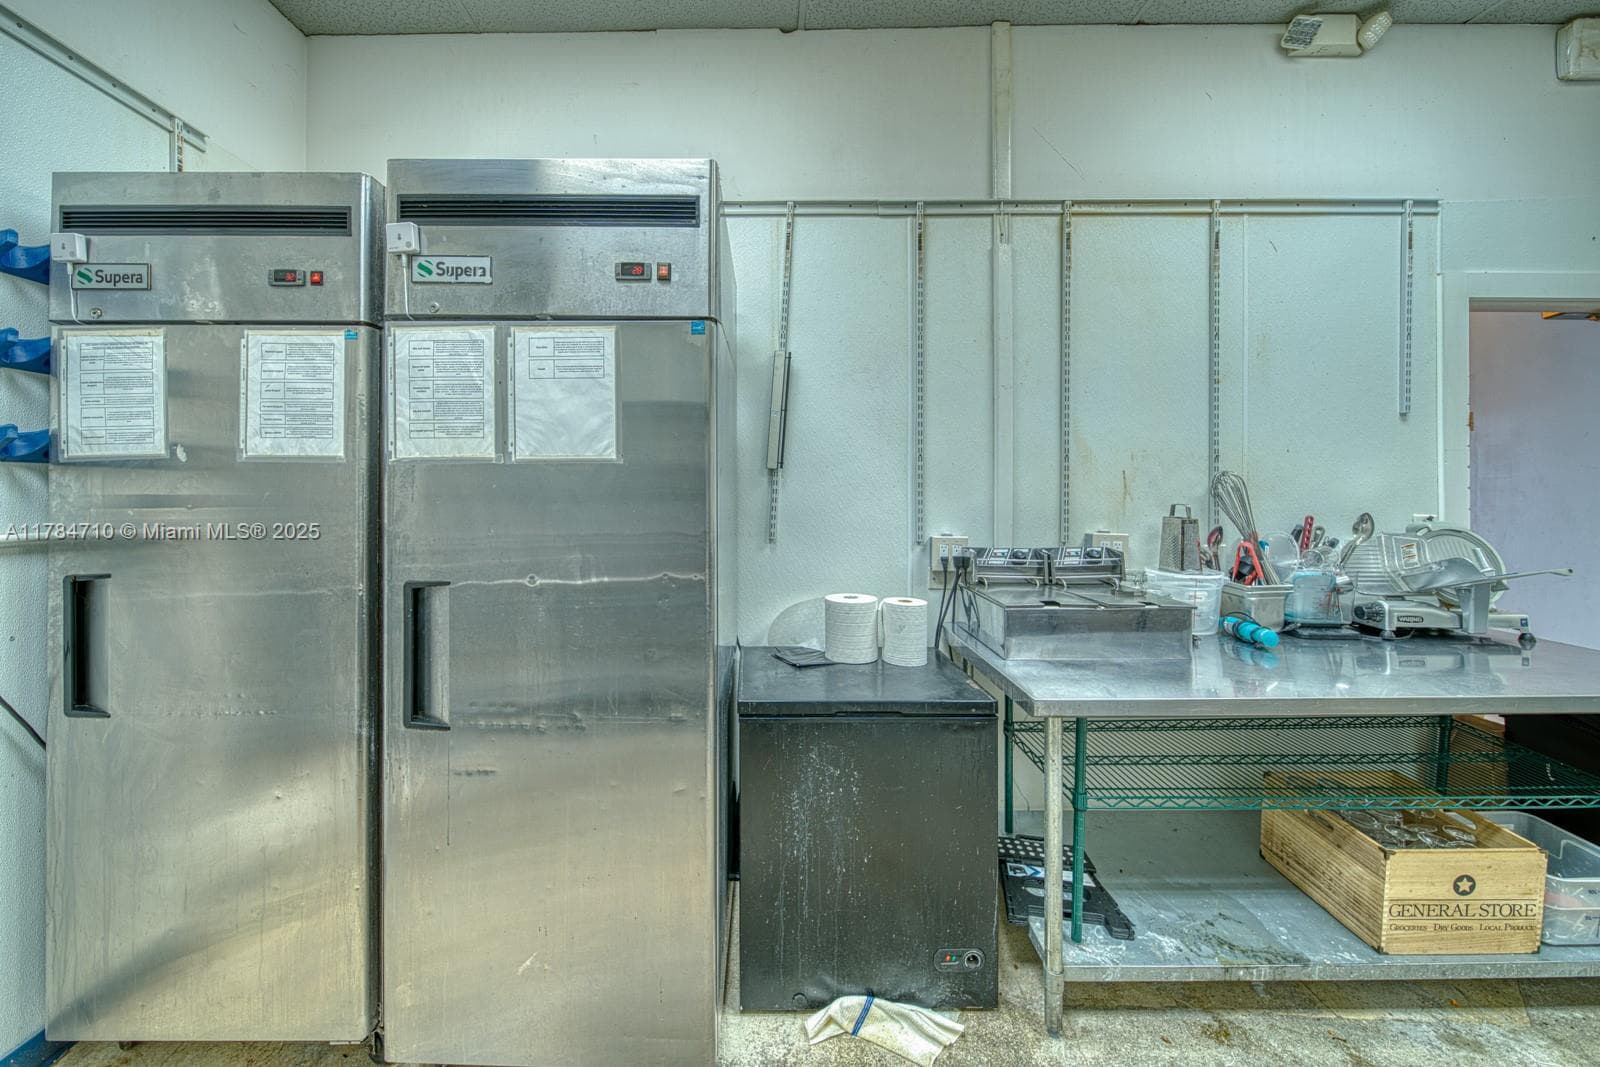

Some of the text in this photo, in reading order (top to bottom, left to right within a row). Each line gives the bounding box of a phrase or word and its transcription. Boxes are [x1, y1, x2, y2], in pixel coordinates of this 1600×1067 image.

[95, 269, 143, 287] Supera
[1389, 903, 1537, 918] GENERAL STORE
